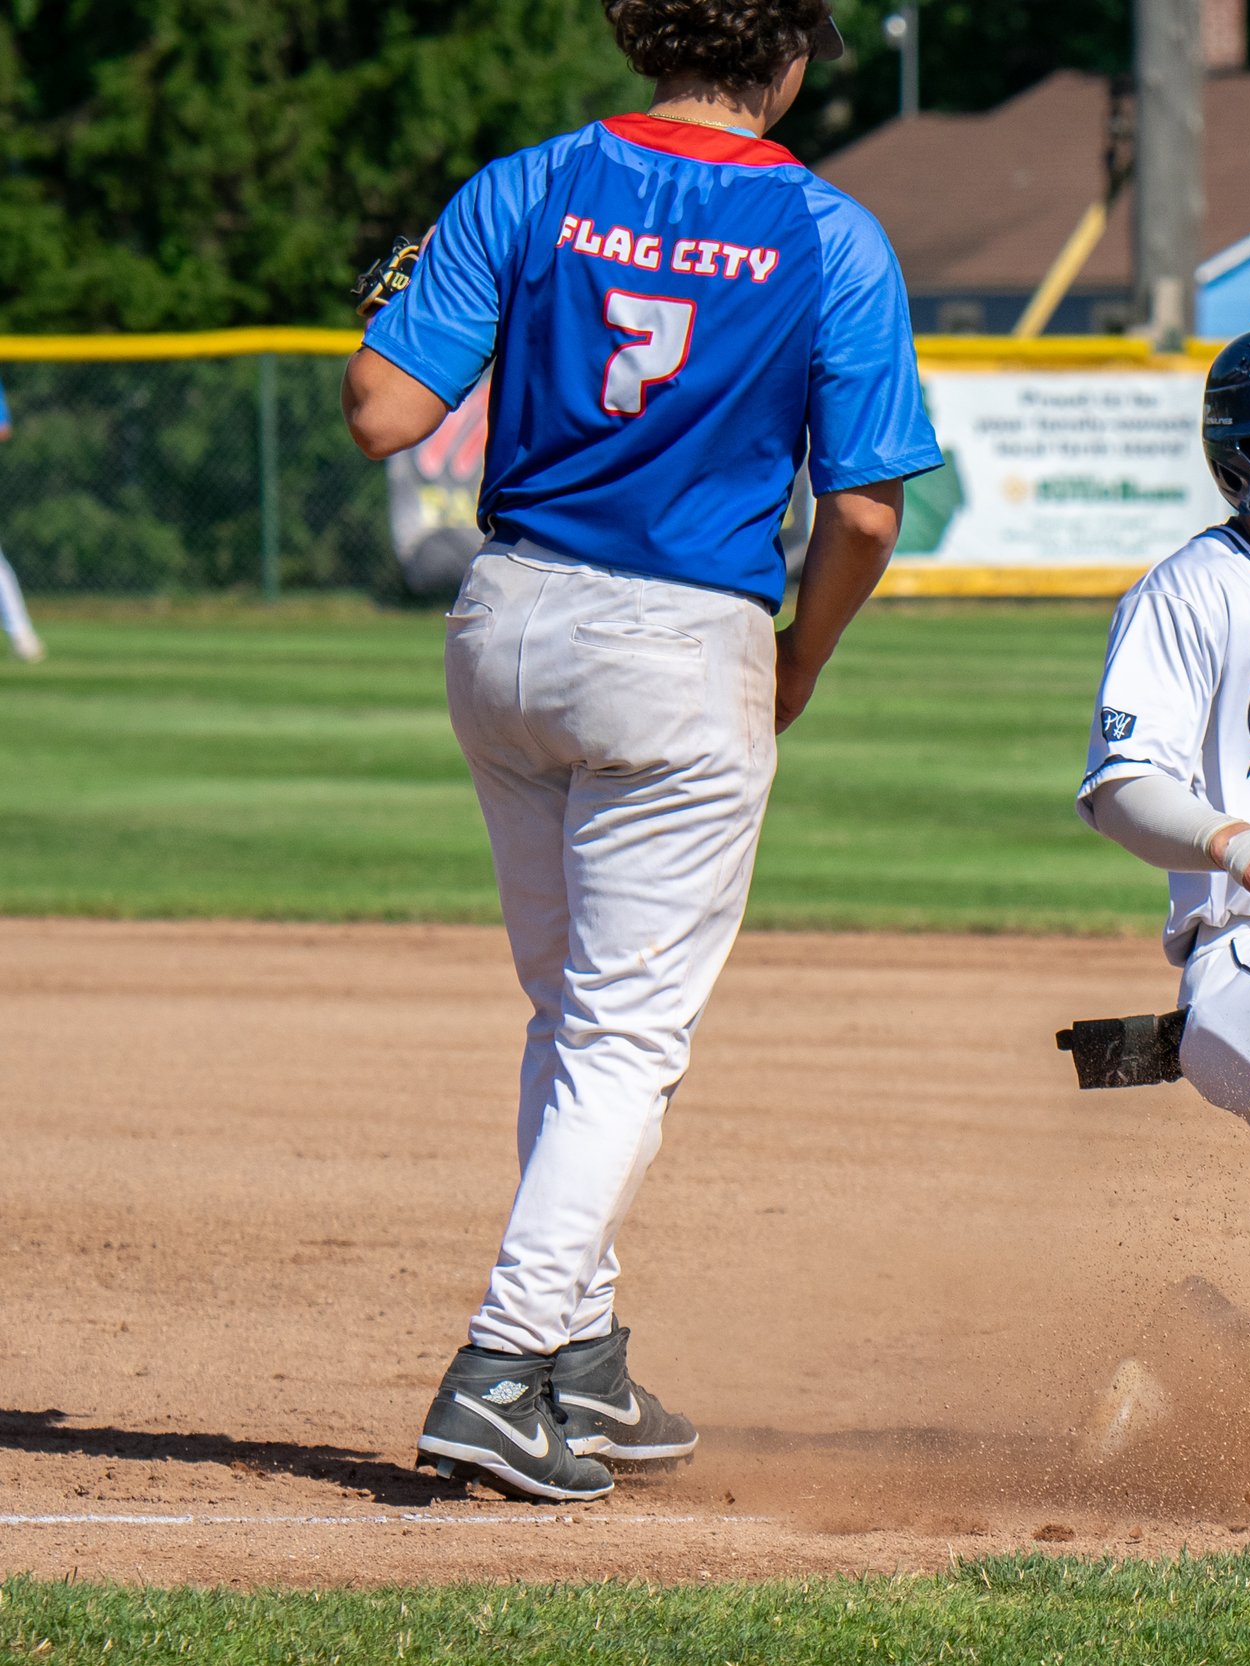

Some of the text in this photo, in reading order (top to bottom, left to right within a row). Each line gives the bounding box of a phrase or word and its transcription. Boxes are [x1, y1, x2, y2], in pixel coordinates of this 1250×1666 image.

[556, 214, 780, 283] FLAG CITY
[600, 287, 697, 418] 7
